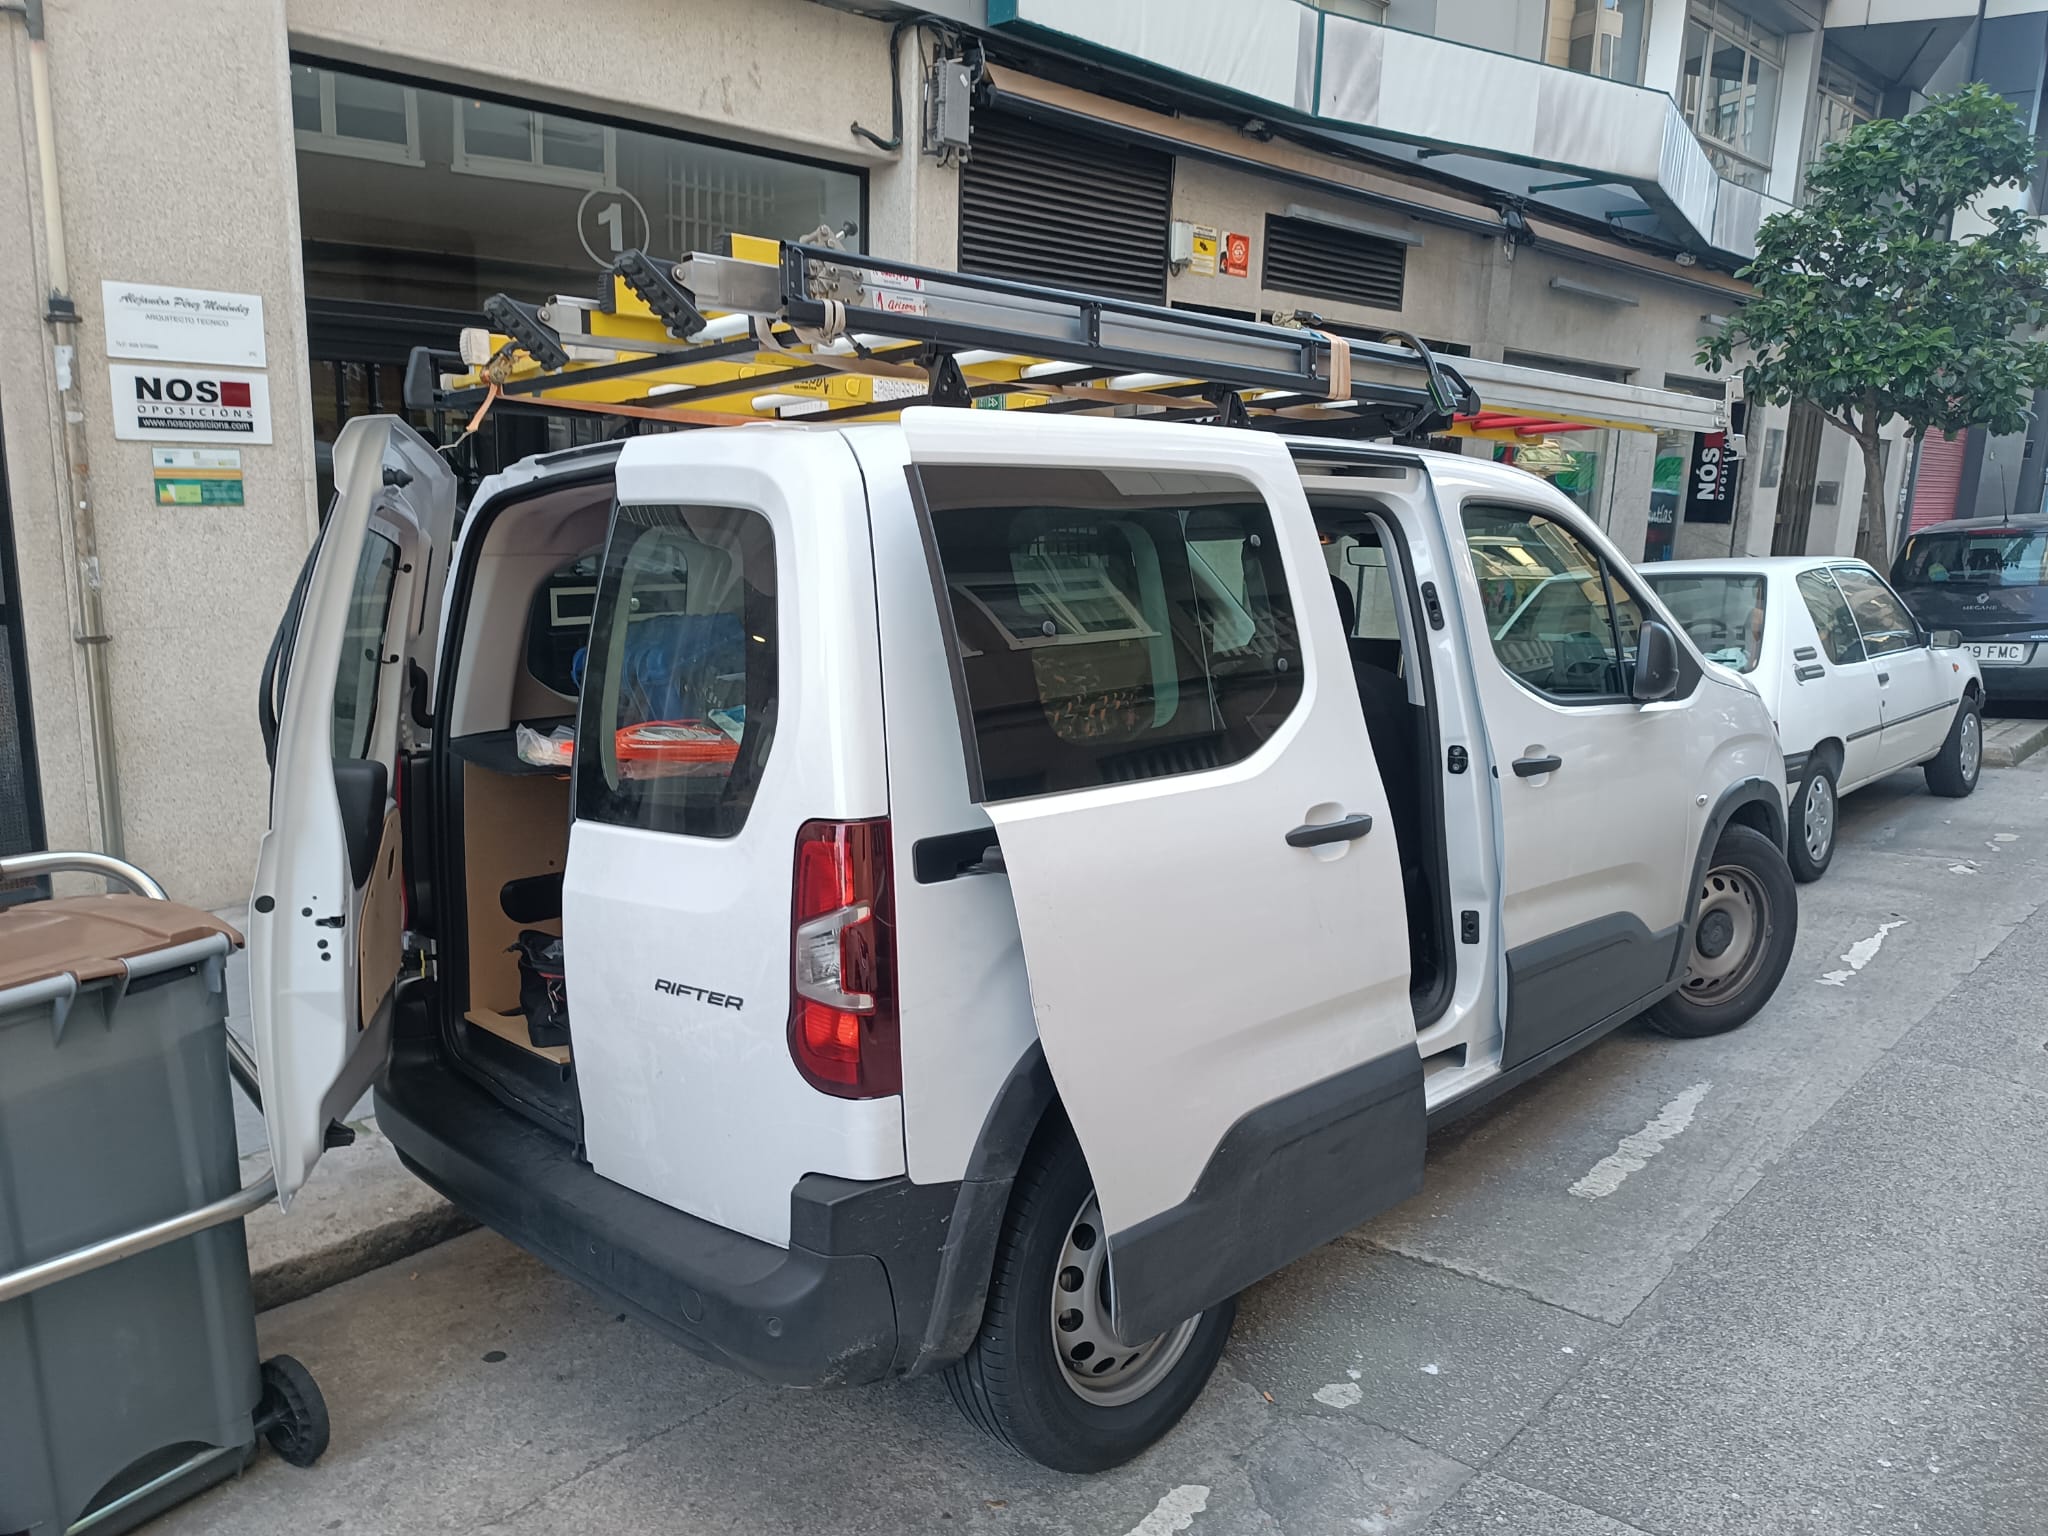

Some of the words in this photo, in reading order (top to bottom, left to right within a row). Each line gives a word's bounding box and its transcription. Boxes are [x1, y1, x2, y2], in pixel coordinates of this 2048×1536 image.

[598, 203, 623, 252] 1
[145, 314, 195, 325] ARQUITECTO
[135, 376, 219, 403] NOS
[142, 418, 250, 431] www.nosoposicions.com
[1696, 447, 1720, 500] NÓS
[1987, 645, 2019, 659] FMC
[654, 978, 744, 1011] RIFTER
